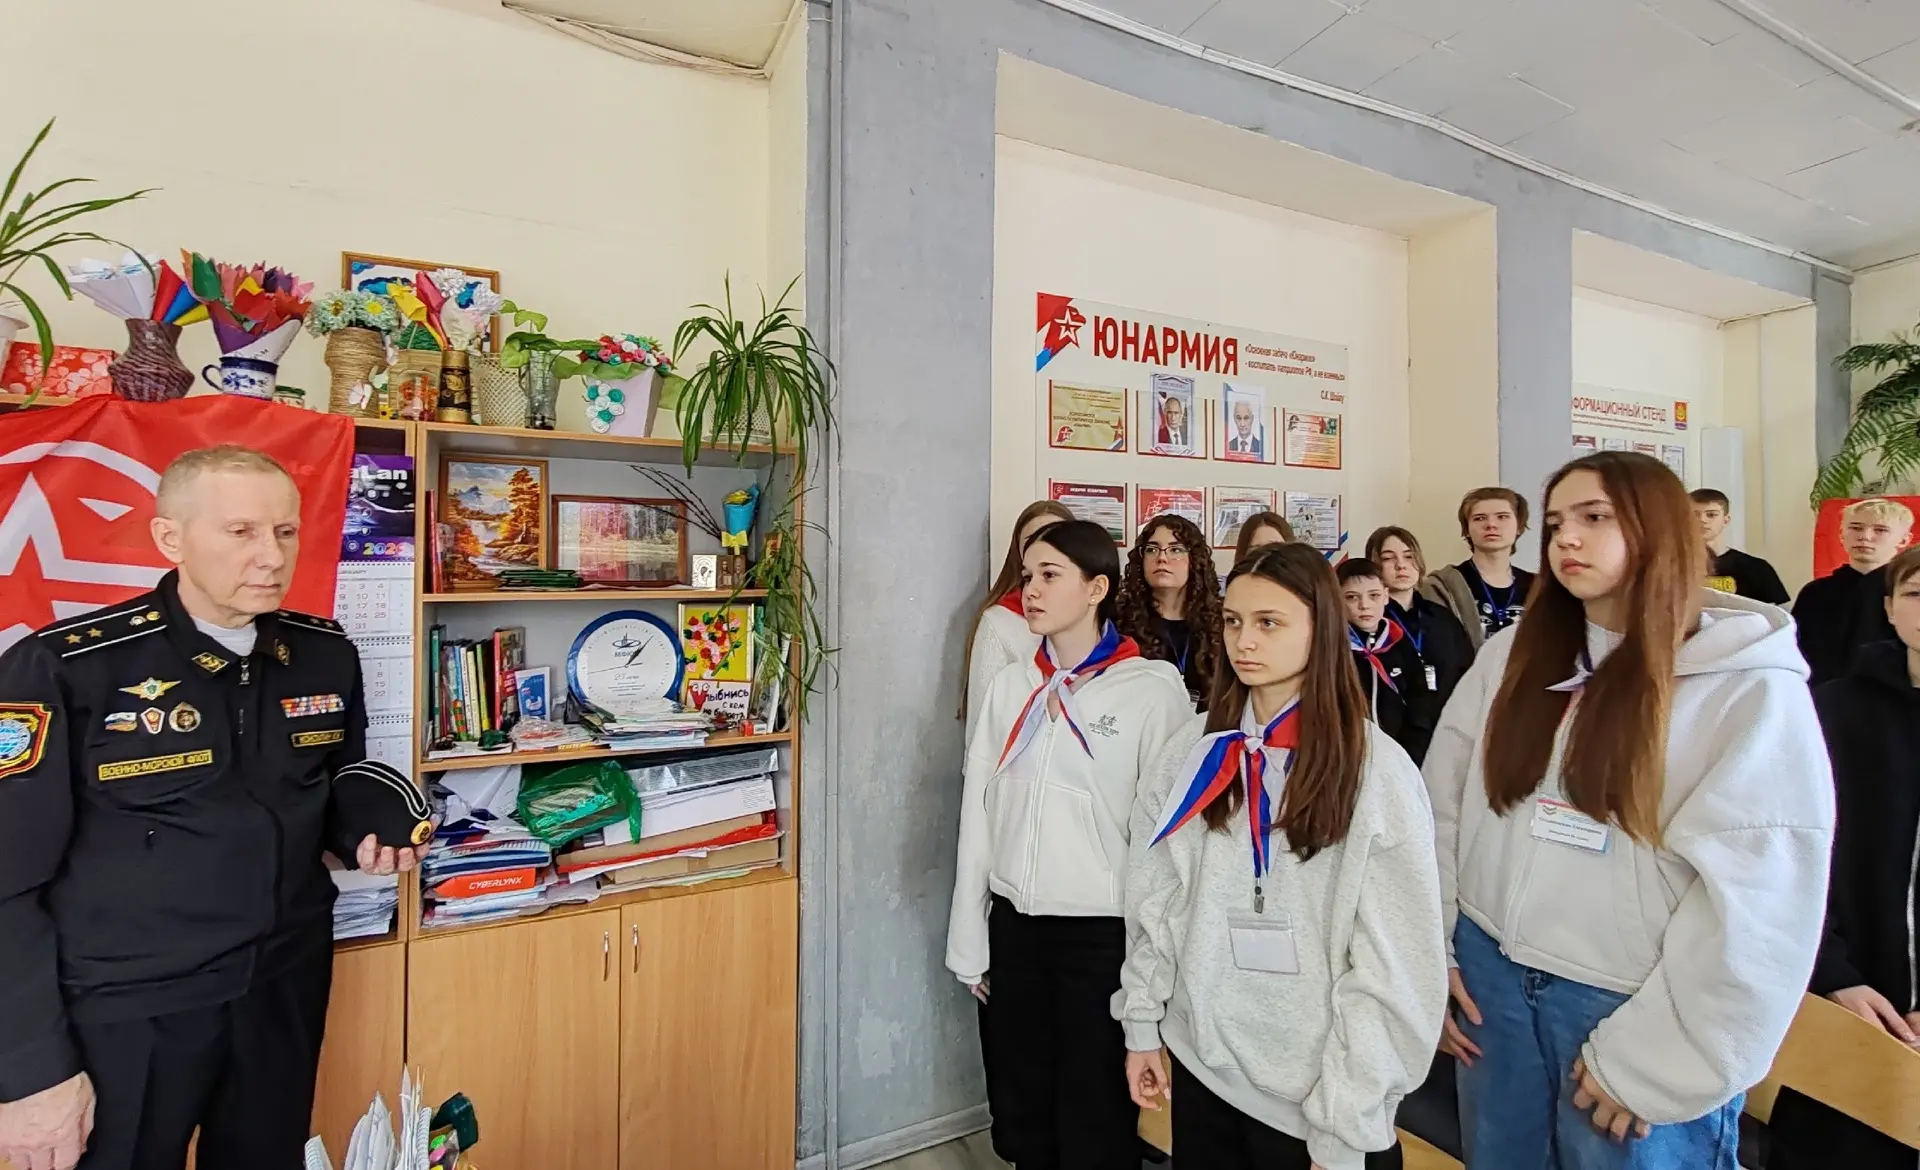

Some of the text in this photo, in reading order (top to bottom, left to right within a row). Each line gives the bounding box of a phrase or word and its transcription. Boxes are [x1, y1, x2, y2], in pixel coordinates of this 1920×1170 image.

[1094, 315, 1238, 376] ЮНАРМИЯ
[1642, 406, 1667, 423] СТЕНД
[374, 611, 387, 619] 25
[102, 753, 211, 777] ВОЕННО-МОРСКОЙ ФЛОТ
[469, 876, 523, 890] CYBERLYNX
